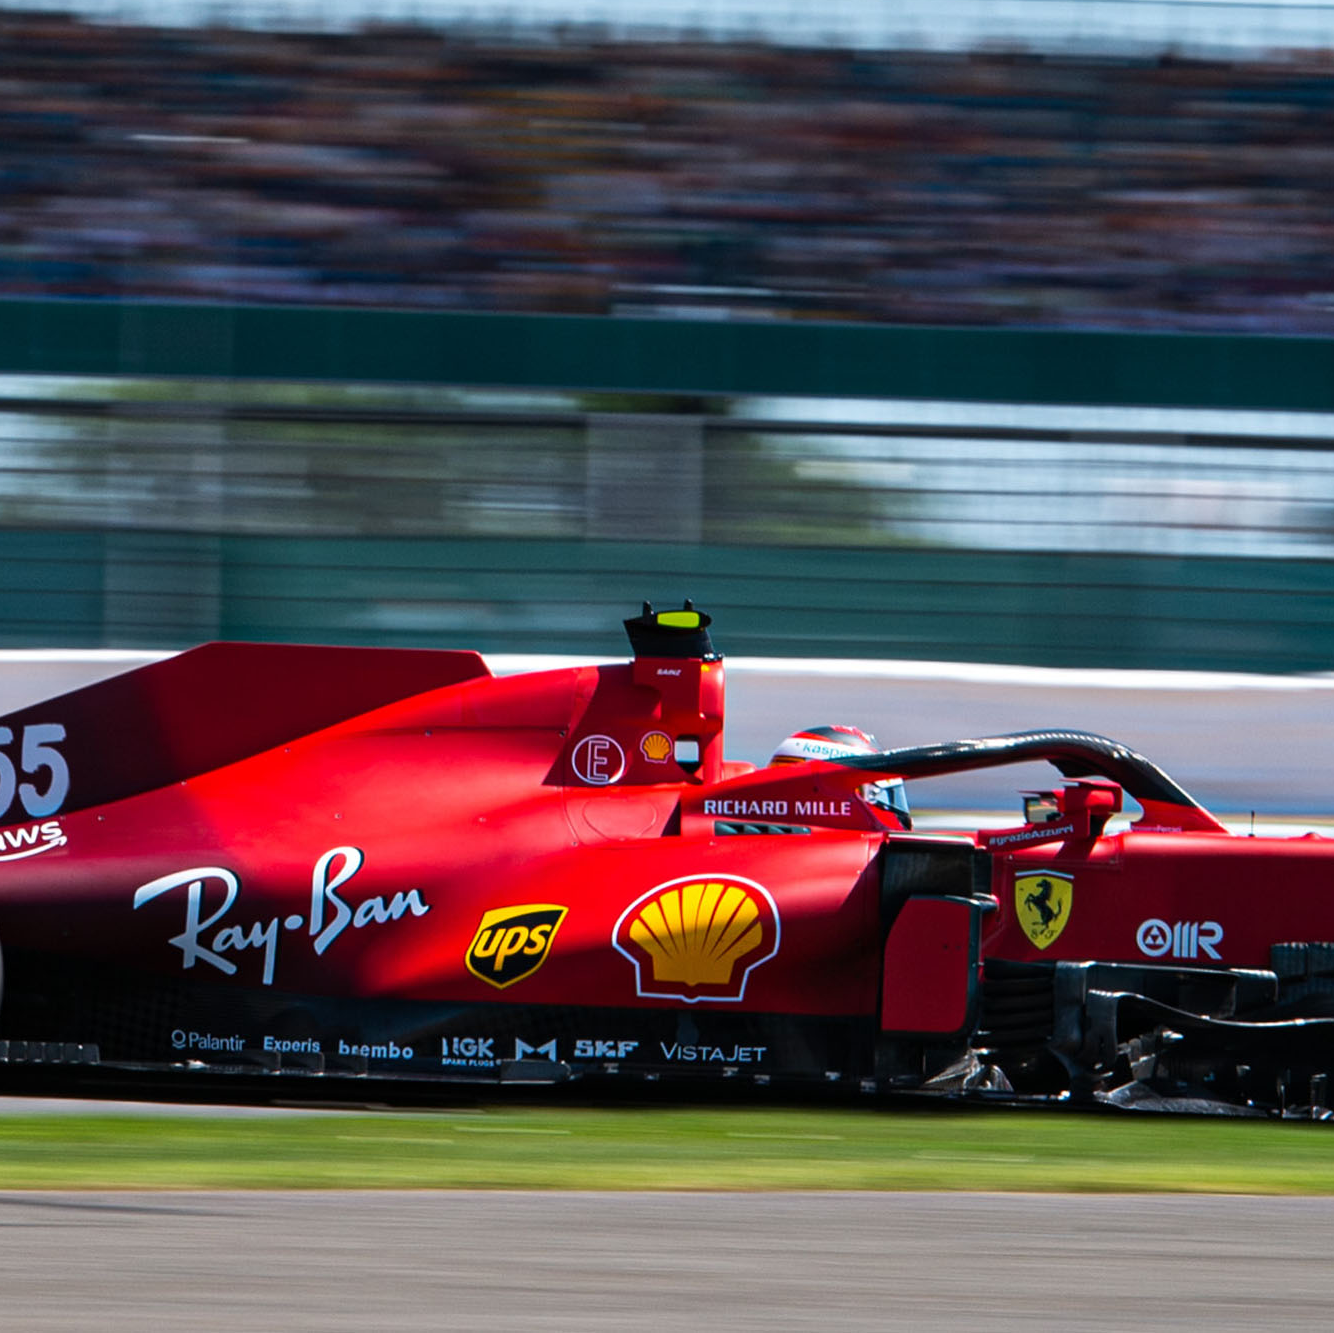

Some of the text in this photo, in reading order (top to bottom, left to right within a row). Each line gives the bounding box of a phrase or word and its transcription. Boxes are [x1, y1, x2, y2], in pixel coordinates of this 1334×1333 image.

[704, 799, 851, 816] RICHARD MILLE
[473, 923, 553, 972] ups
[188, 1033, 246, 1052] Palantir
[263, 1035, 321, 1054] Experis
[338, 1039, 414, 1060] brembo
[574, 1039, 639, 1058] SKF
